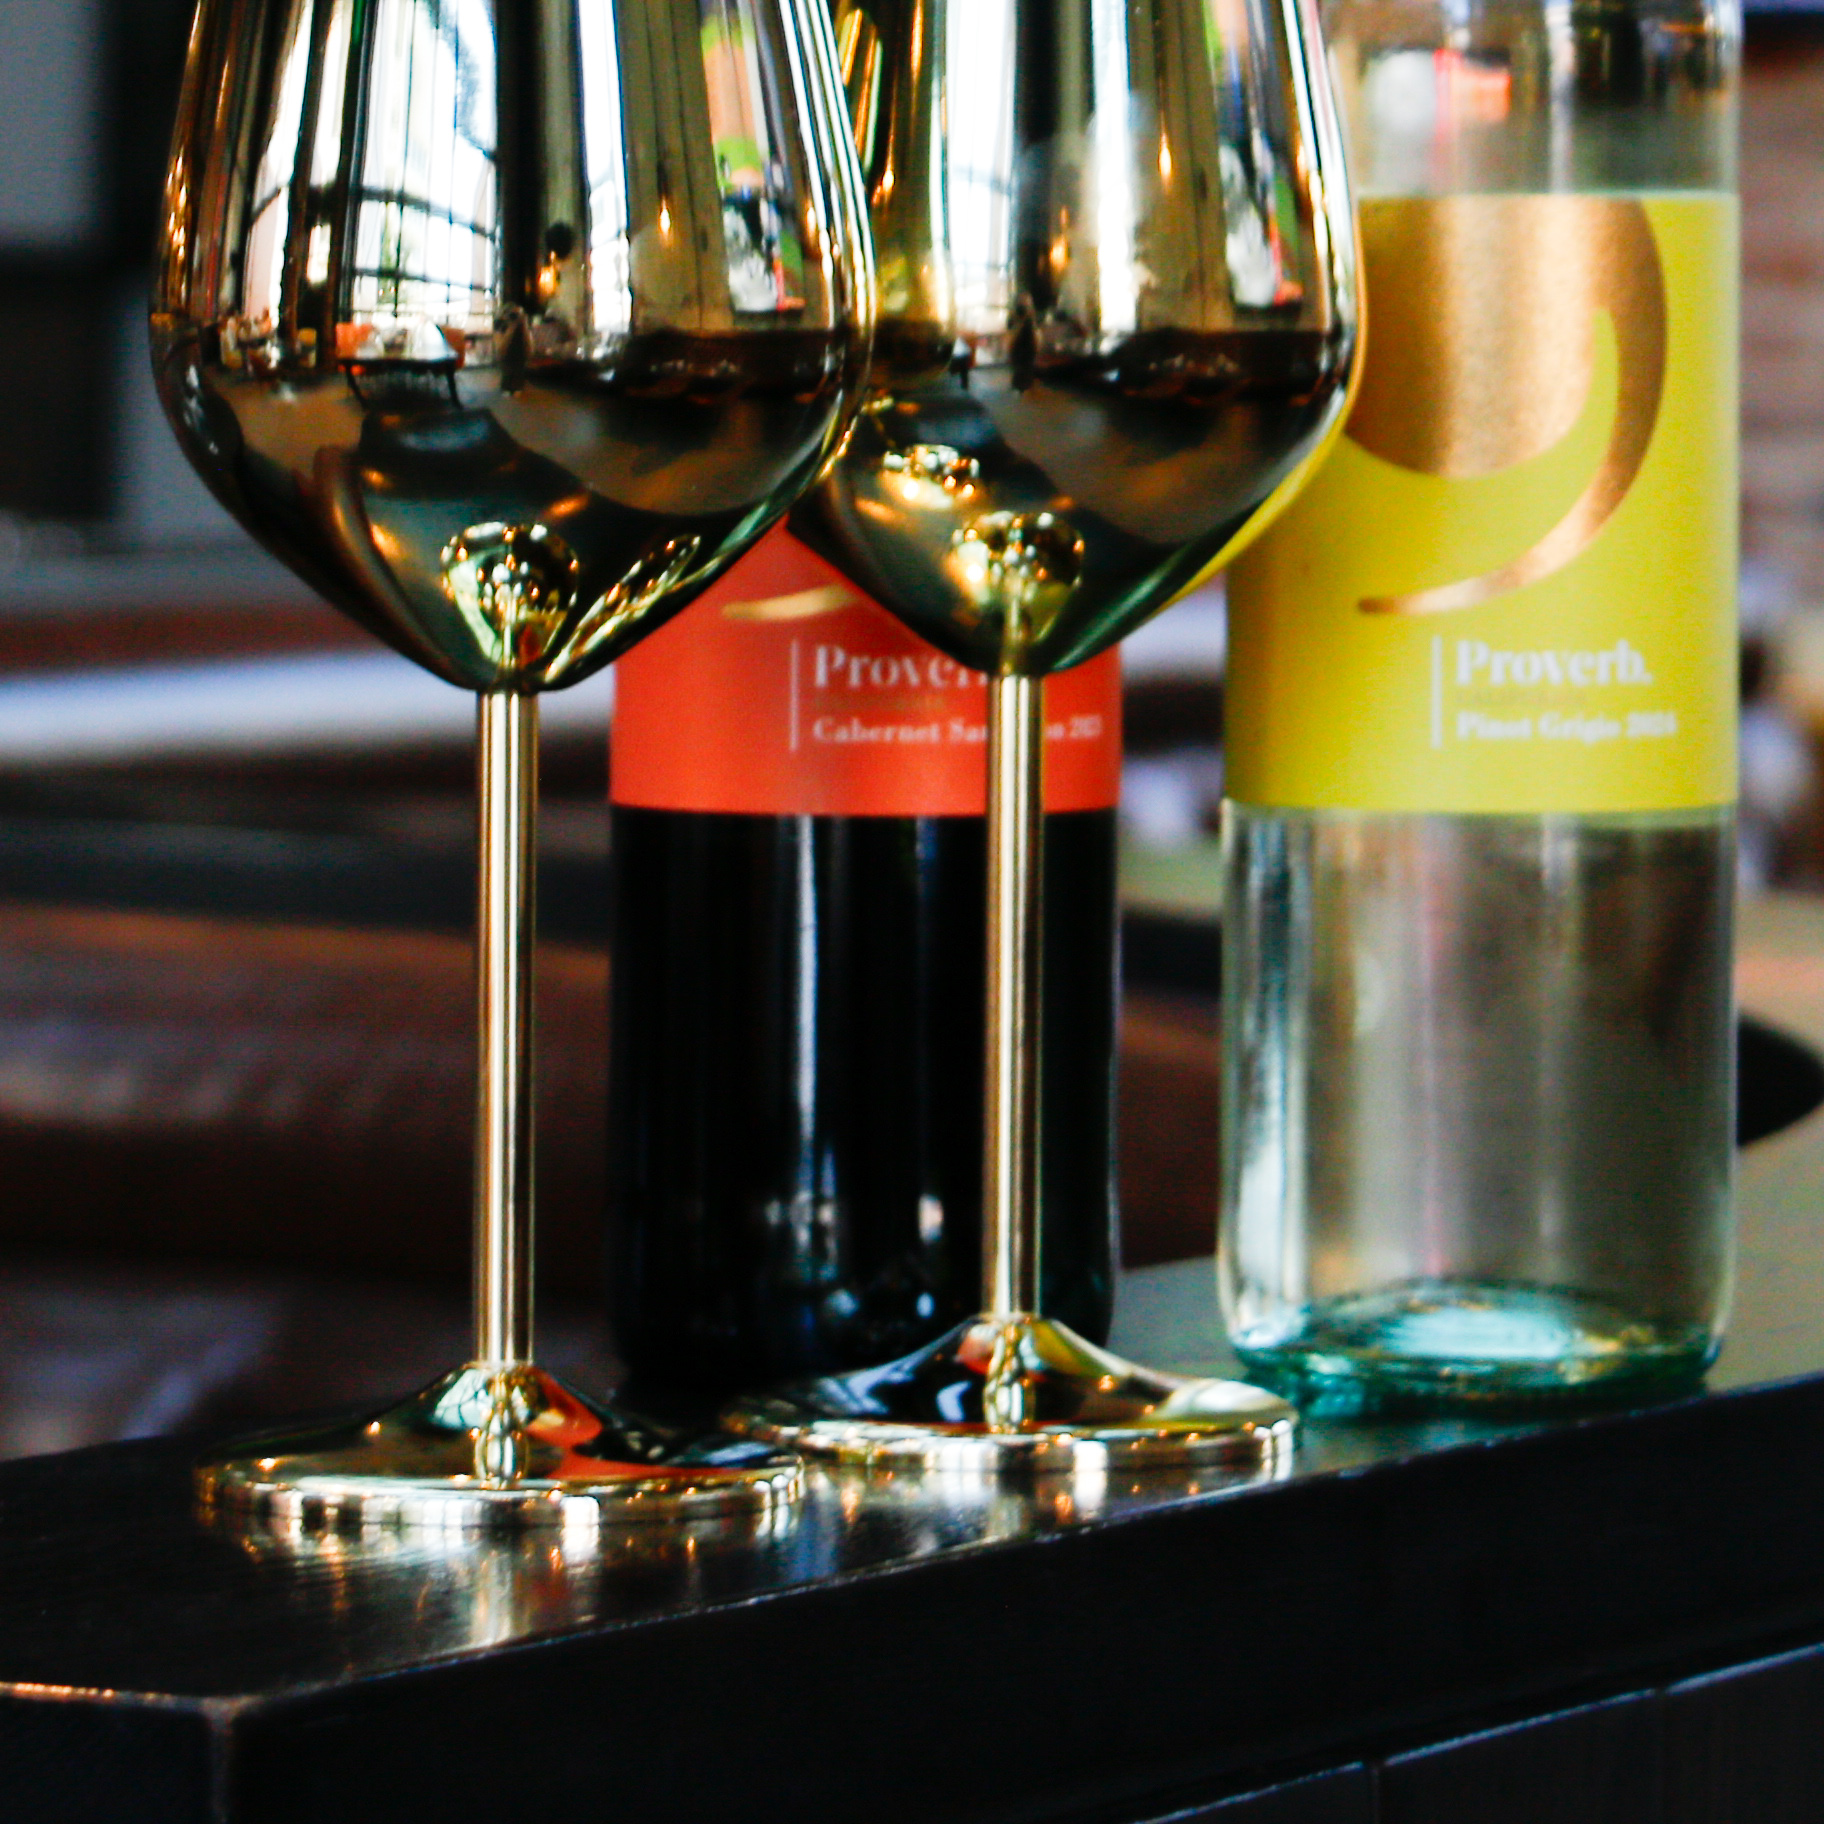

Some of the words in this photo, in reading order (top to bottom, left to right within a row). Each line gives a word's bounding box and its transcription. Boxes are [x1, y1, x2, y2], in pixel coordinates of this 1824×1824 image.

[813, 717, 941, 744] Cabernet
[1456, 710, 1532, 742] Pinot
[1537, 709, 1622, 746] Grigio
